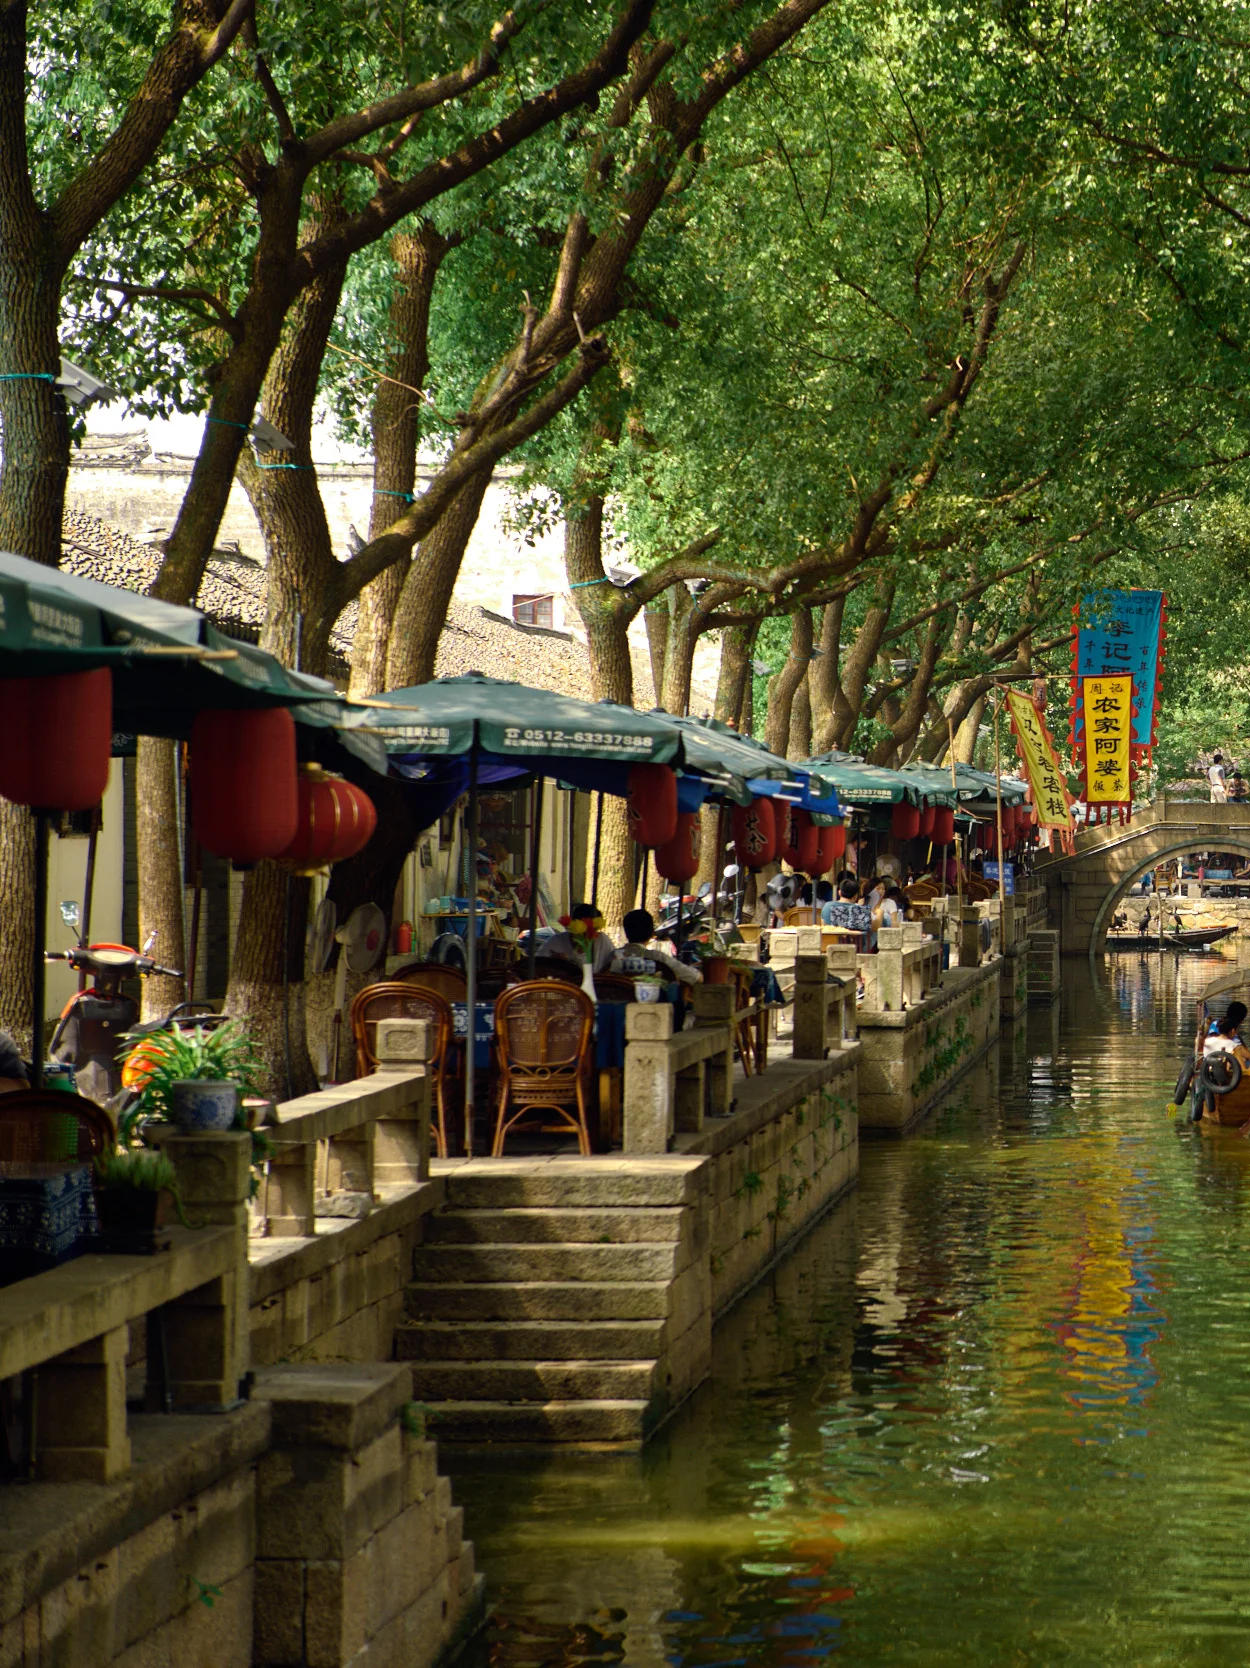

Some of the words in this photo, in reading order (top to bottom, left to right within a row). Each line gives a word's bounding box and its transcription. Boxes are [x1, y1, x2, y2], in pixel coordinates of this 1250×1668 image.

[1090, 682, 1123, 695] 周记
[524, 729, 653, 746] 0512-63337888
[1092, 697, 1122, 777] 农家阿婆
